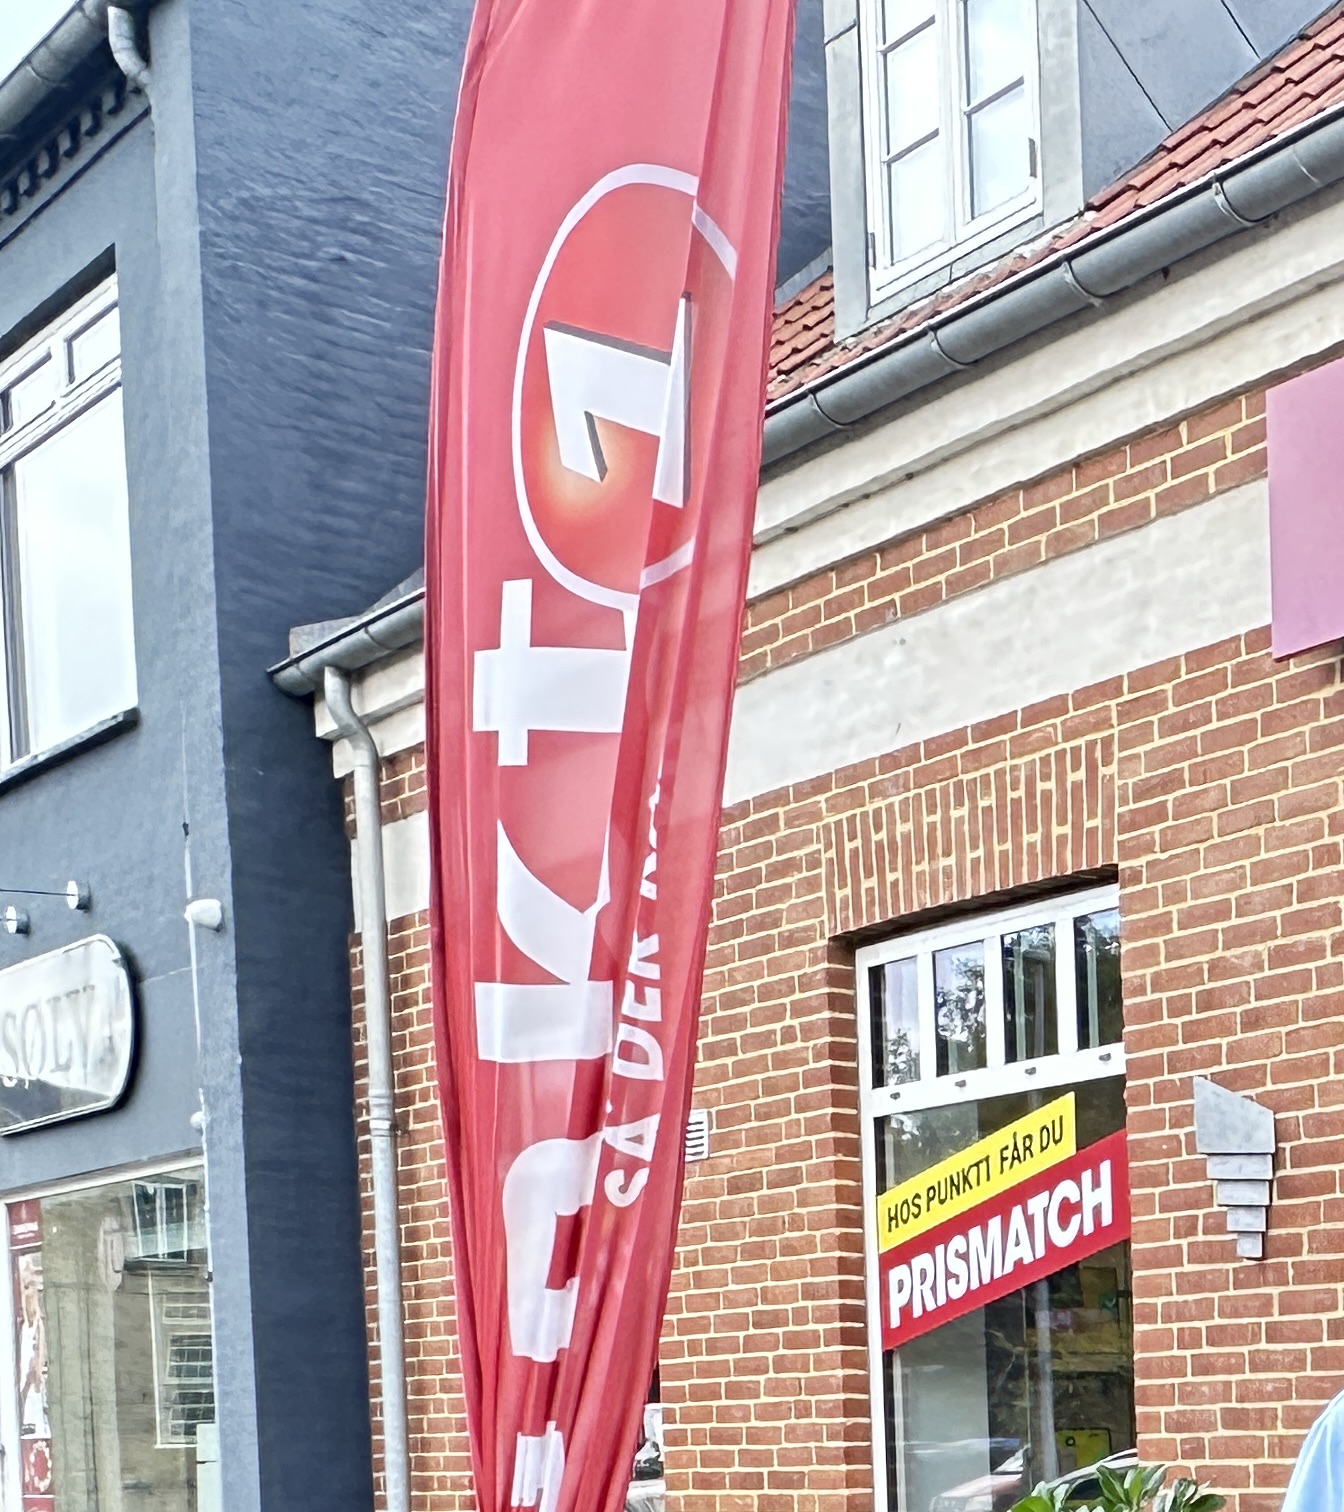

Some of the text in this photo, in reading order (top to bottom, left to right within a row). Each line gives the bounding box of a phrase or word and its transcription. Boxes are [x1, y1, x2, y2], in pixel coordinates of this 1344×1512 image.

[888, 1115, 1063, 1232] HOS PUNKT1 FÅR DU
[889, 1159, 1113, 1328] PRISMATCH
